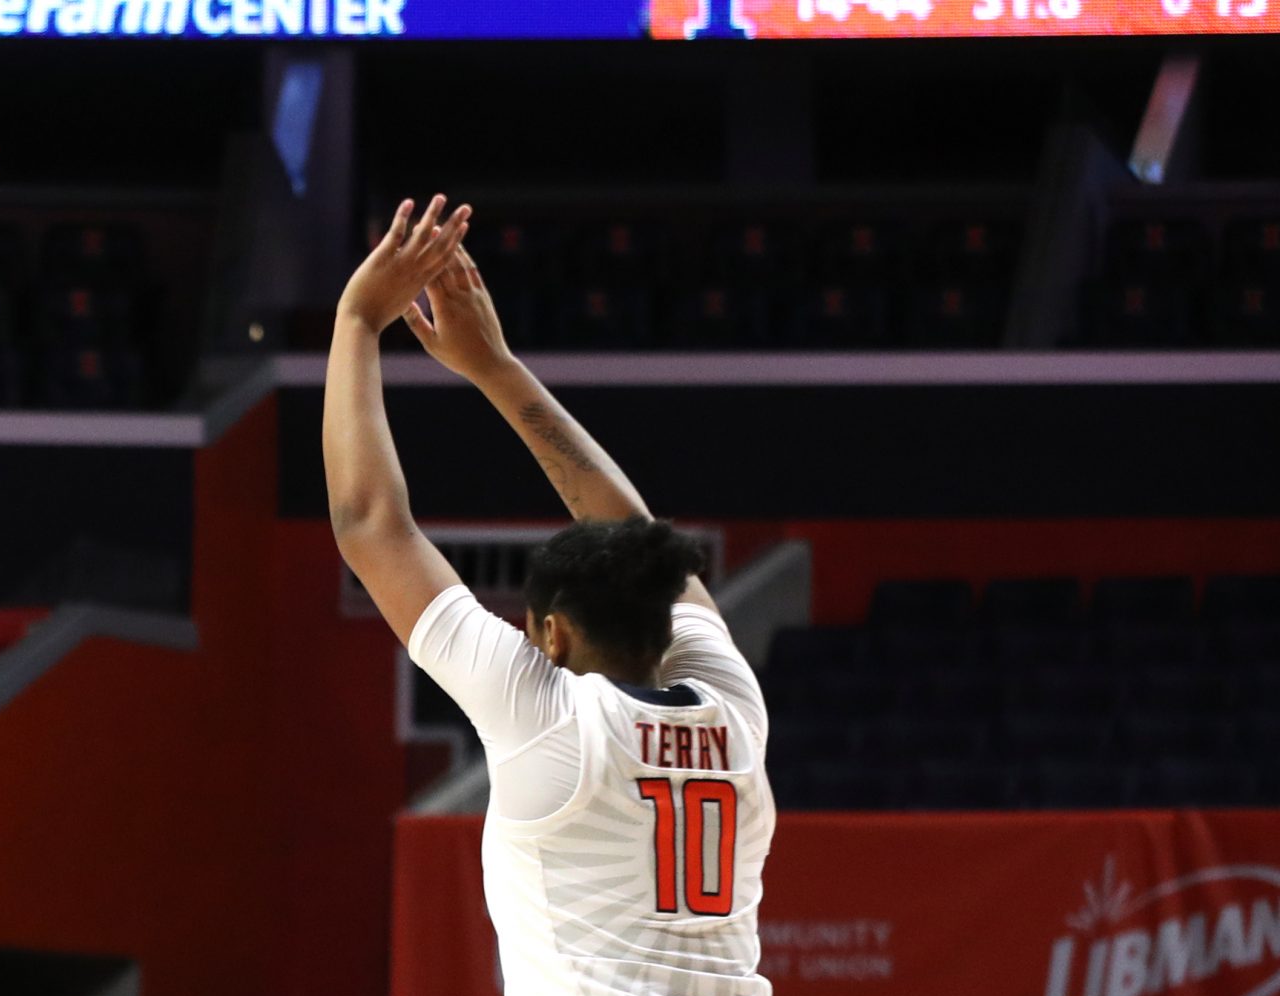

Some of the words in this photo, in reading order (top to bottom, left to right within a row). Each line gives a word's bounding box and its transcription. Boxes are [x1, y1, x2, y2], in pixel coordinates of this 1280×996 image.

[192, 0, 406, 35] CENTER
[635, 722, 731, 771] TERRY
[636, 777, 738, 917] 10
